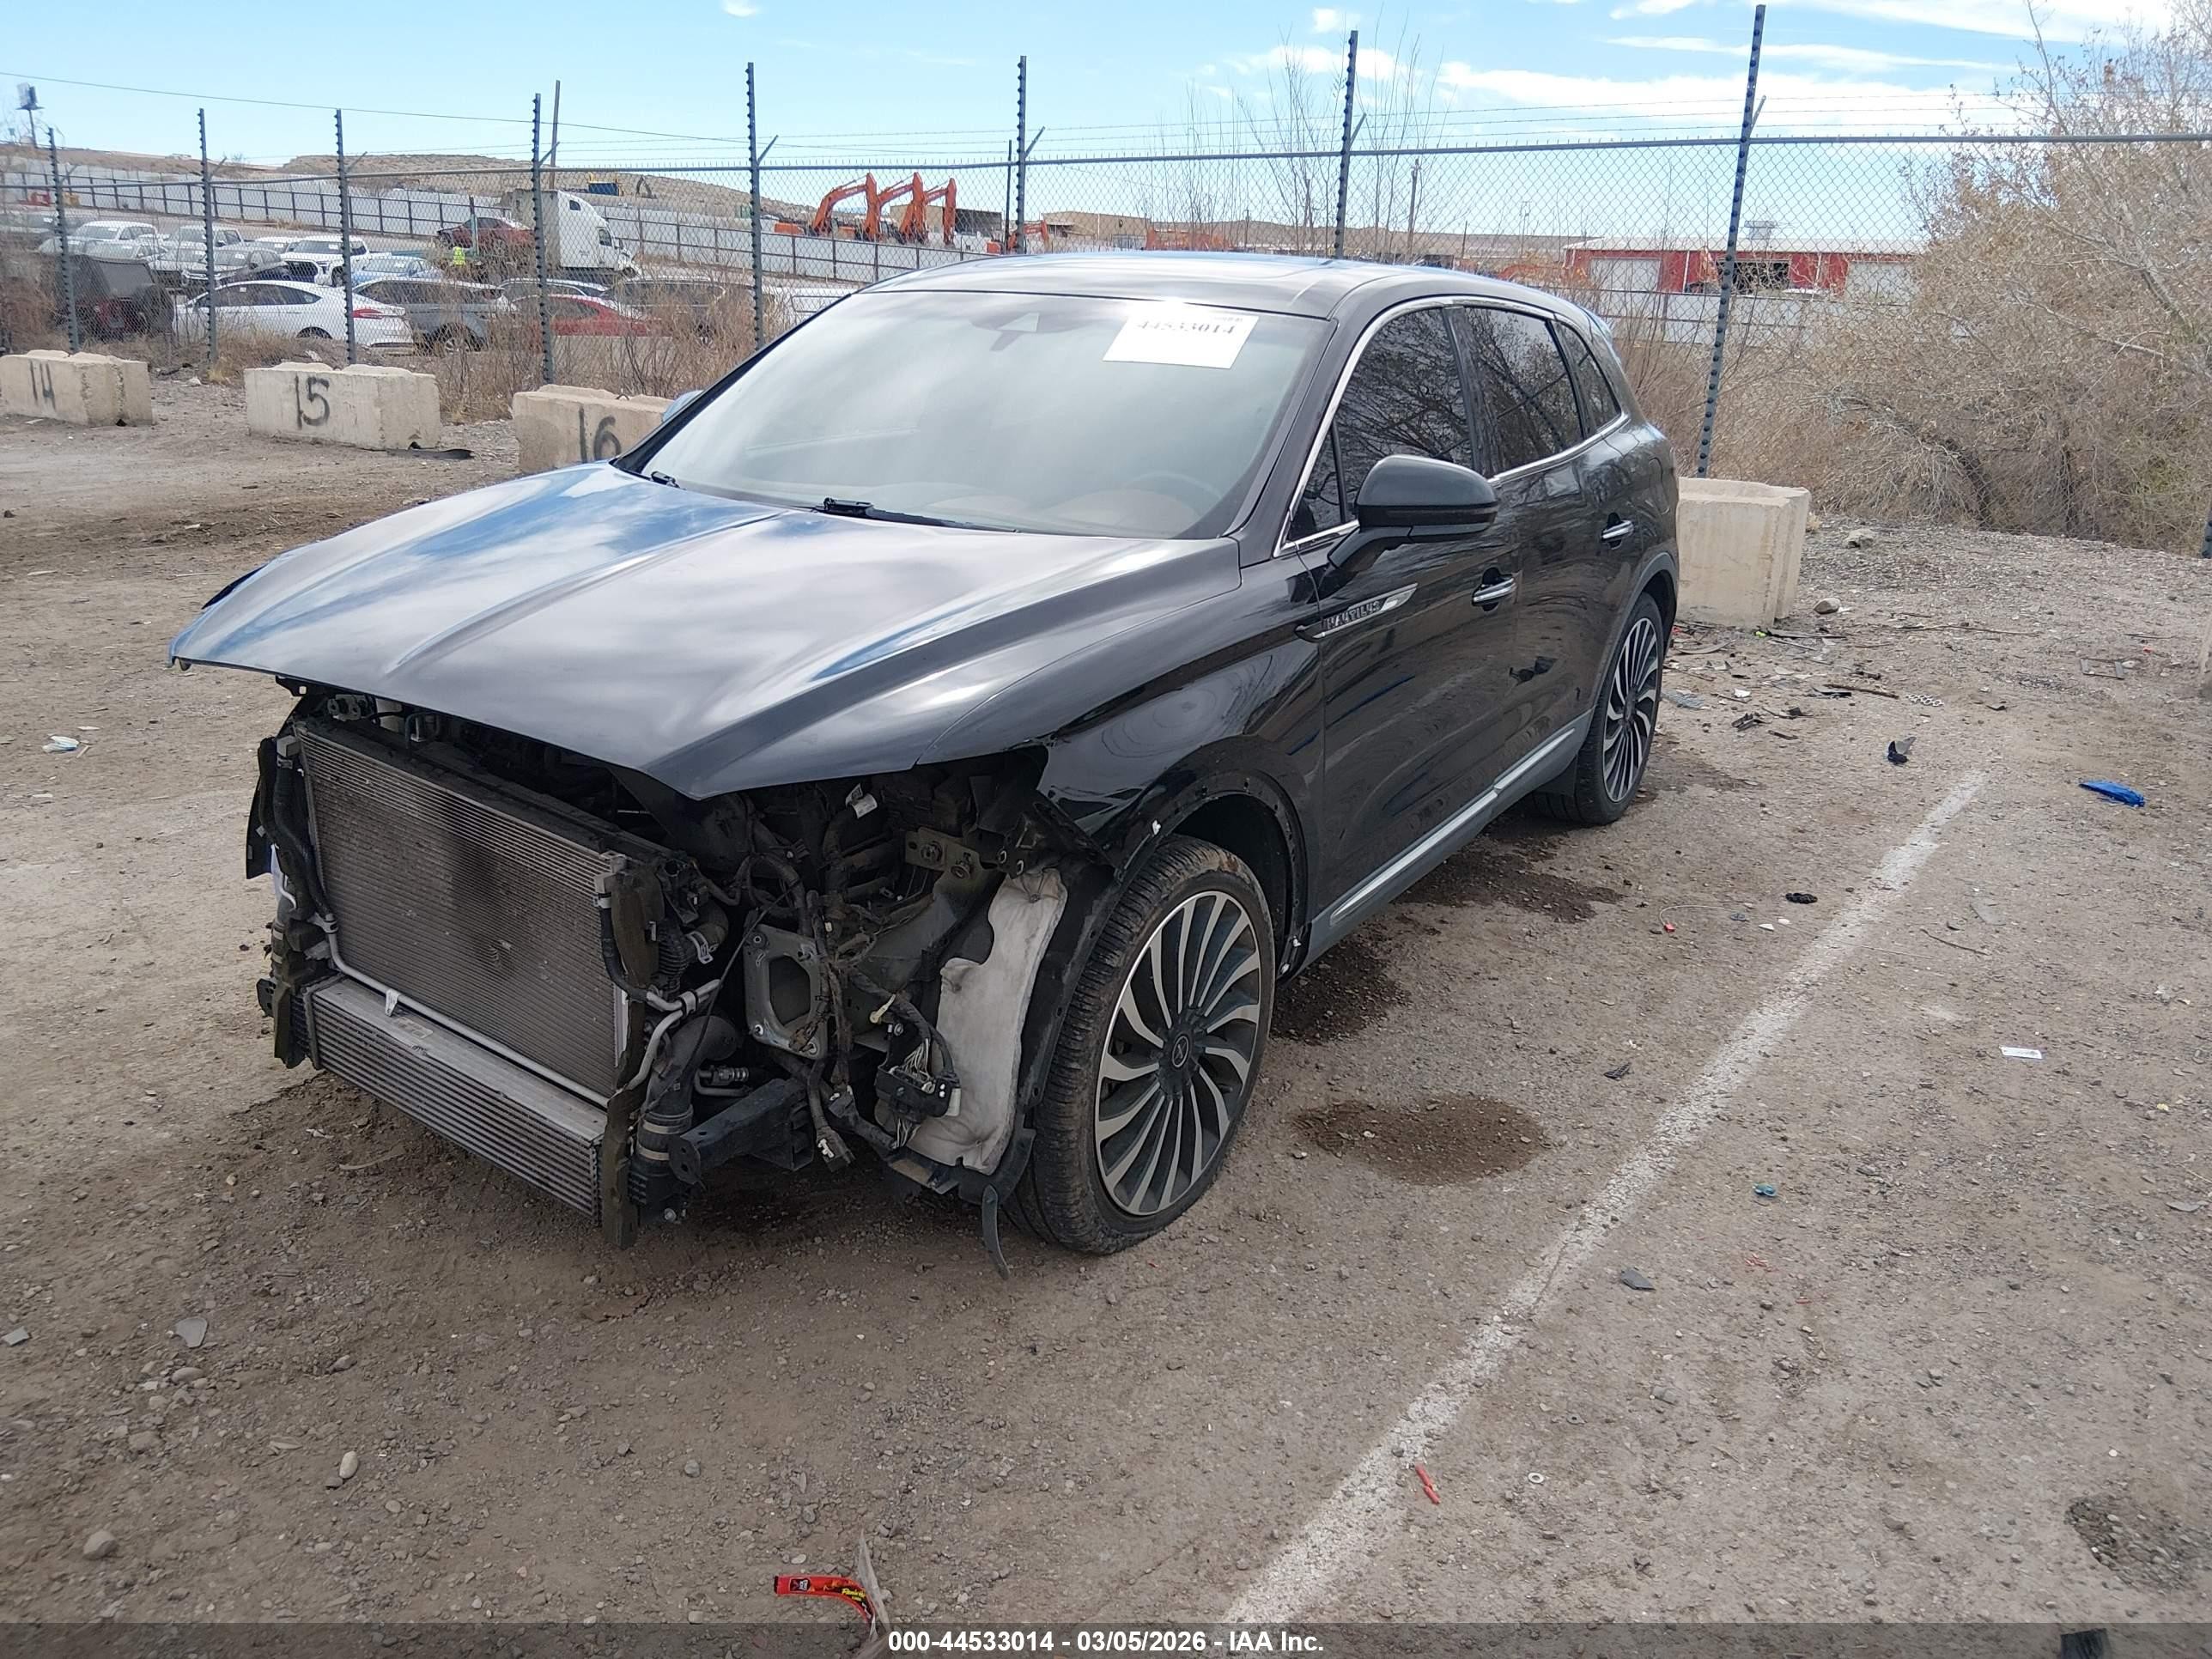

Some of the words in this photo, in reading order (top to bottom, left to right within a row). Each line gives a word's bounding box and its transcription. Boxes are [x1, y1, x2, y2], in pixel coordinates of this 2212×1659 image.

[29, 360, 56, 410] 14
[295, 374, 331, 430] 15
[578, 405, 622, 464] 16
